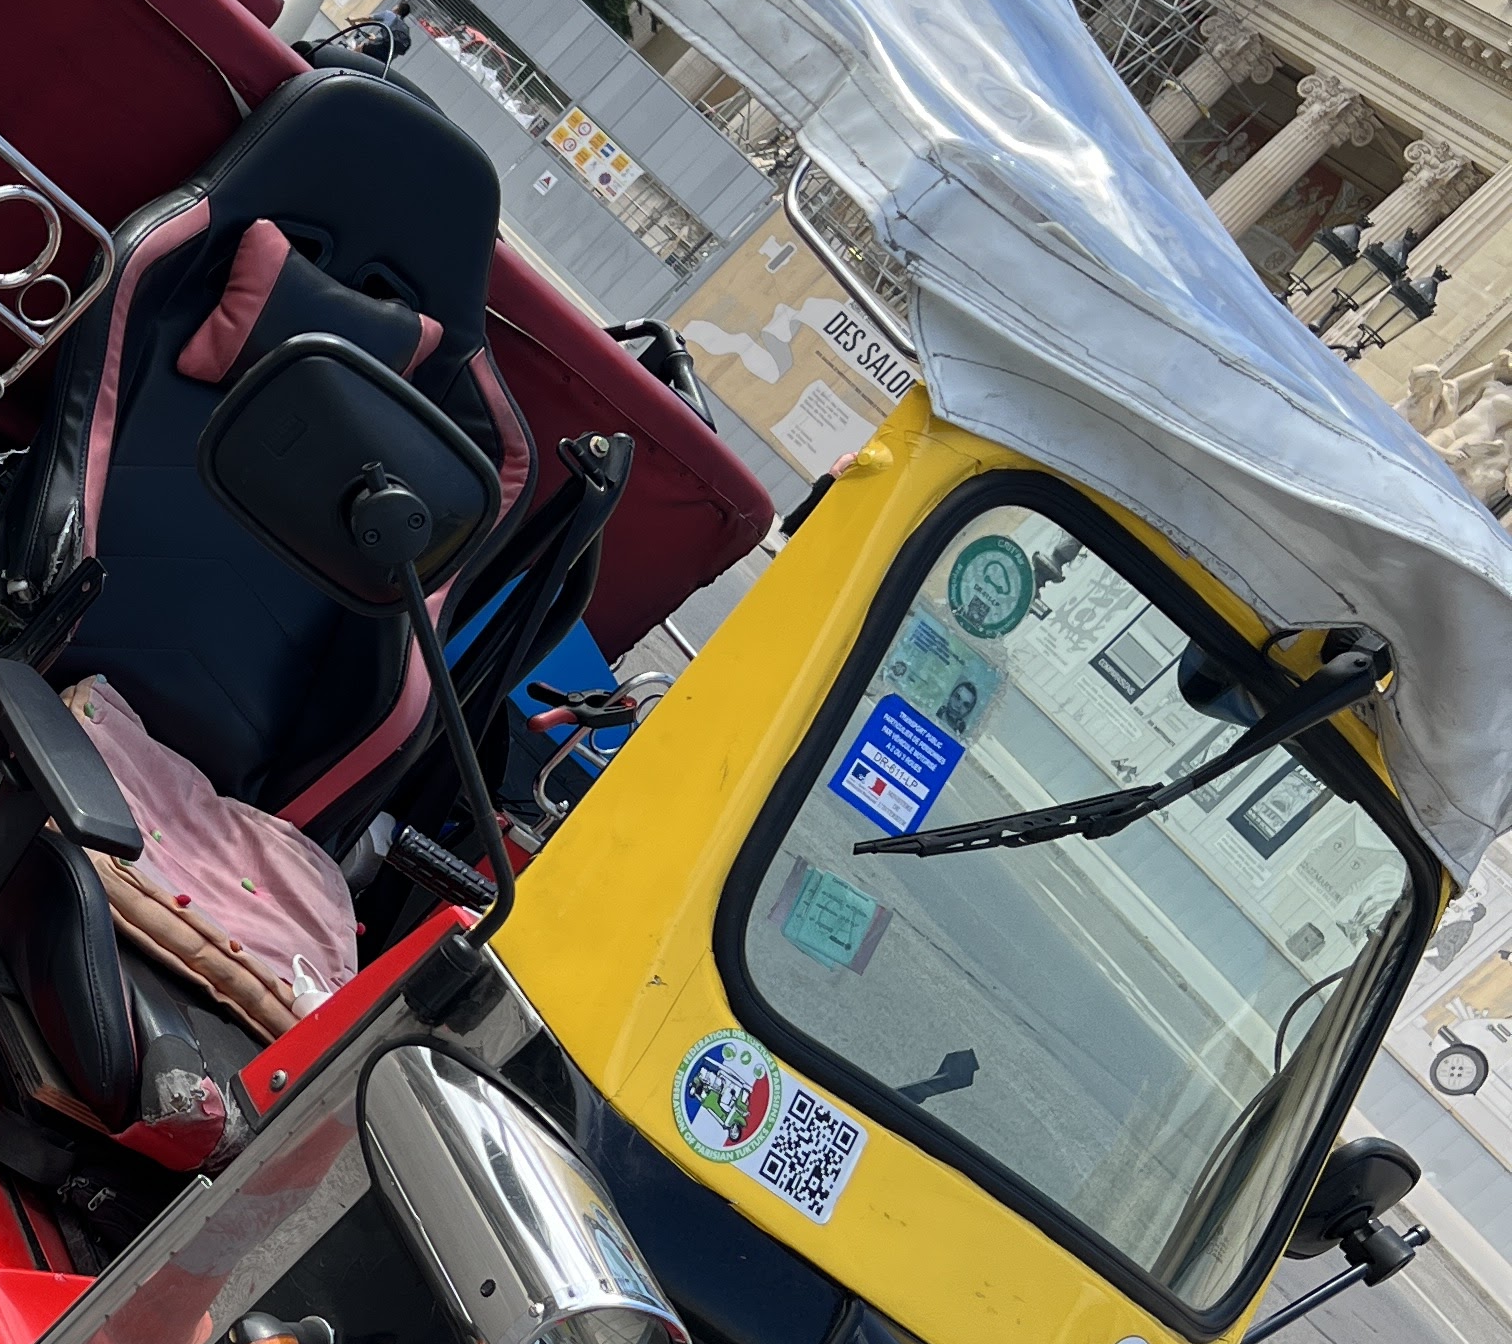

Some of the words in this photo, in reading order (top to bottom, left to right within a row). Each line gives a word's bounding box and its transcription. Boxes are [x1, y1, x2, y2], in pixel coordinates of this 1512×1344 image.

[822, 310, 867, 353] DES
[880, 724, 893, 737] PAR
[882, 712, 914, 741] PARTICULIER
[911, 735, 920, 745] DE
[898, 710, 927, 737] TRANSPORT
[925, 731, 943, 749] PUBLIC
[872, 751, 919, 790] DR-611-LP
[893, 747, 902, 758] OU
[903, 756, 922, 773] ROUES
[683, 1030, 731, 1065] FEDERATION
[732, 1030, 746, 1040] DES
[684, 1131, 696, 1145] OF
[694, 1142, 735, 1161] PARISIAN
[734, 1127, 770, 1159] TUKTUKS
